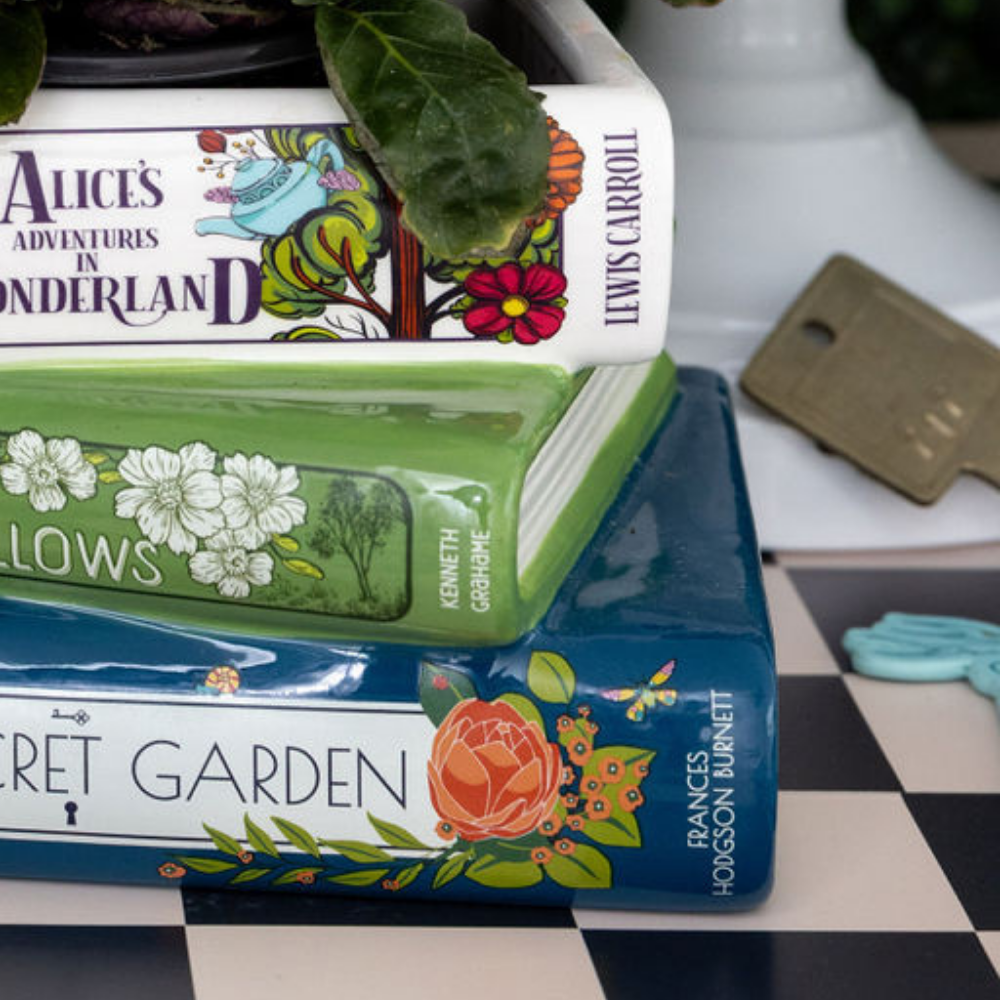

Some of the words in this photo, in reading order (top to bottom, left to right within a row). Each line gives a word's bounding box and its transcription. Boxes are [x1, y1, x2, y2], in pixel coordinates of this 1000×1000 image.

[604, 128, 640, 247] CARROLL
[12, 227, 159, 251] ADVENTURES
[76, 252, 98, 273] IN
[604, 256, 640, 328] LEWIS
[439, 527, 461, 609] KENNETH
[131, 740, 408, 810] GARDEN
[710, 690, 734, 779] BURNETT
[687, 750, 709, 849] FRANCES
[712, 787, 735, 896] HODGSON
